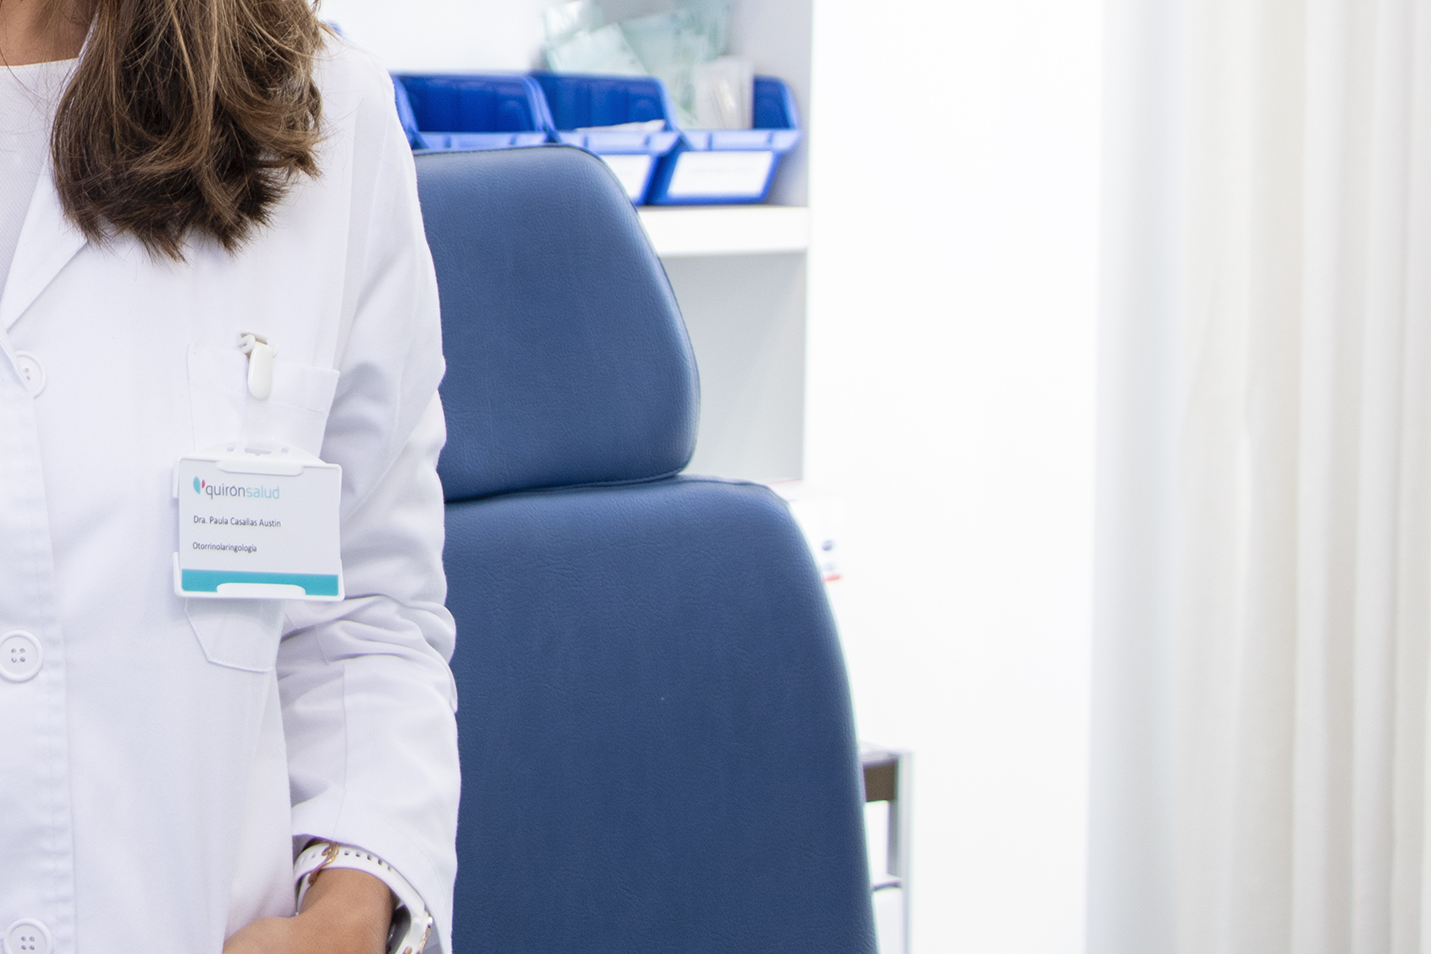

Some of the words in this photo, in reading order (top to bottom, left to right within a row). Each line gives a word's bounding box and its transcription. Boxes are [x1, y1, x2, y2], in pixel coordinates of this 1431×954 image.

[193, 515, 208, 524] Dra.
[209, 516, 228, 525] Paula
[230, 517, 257, 526] Casallas
